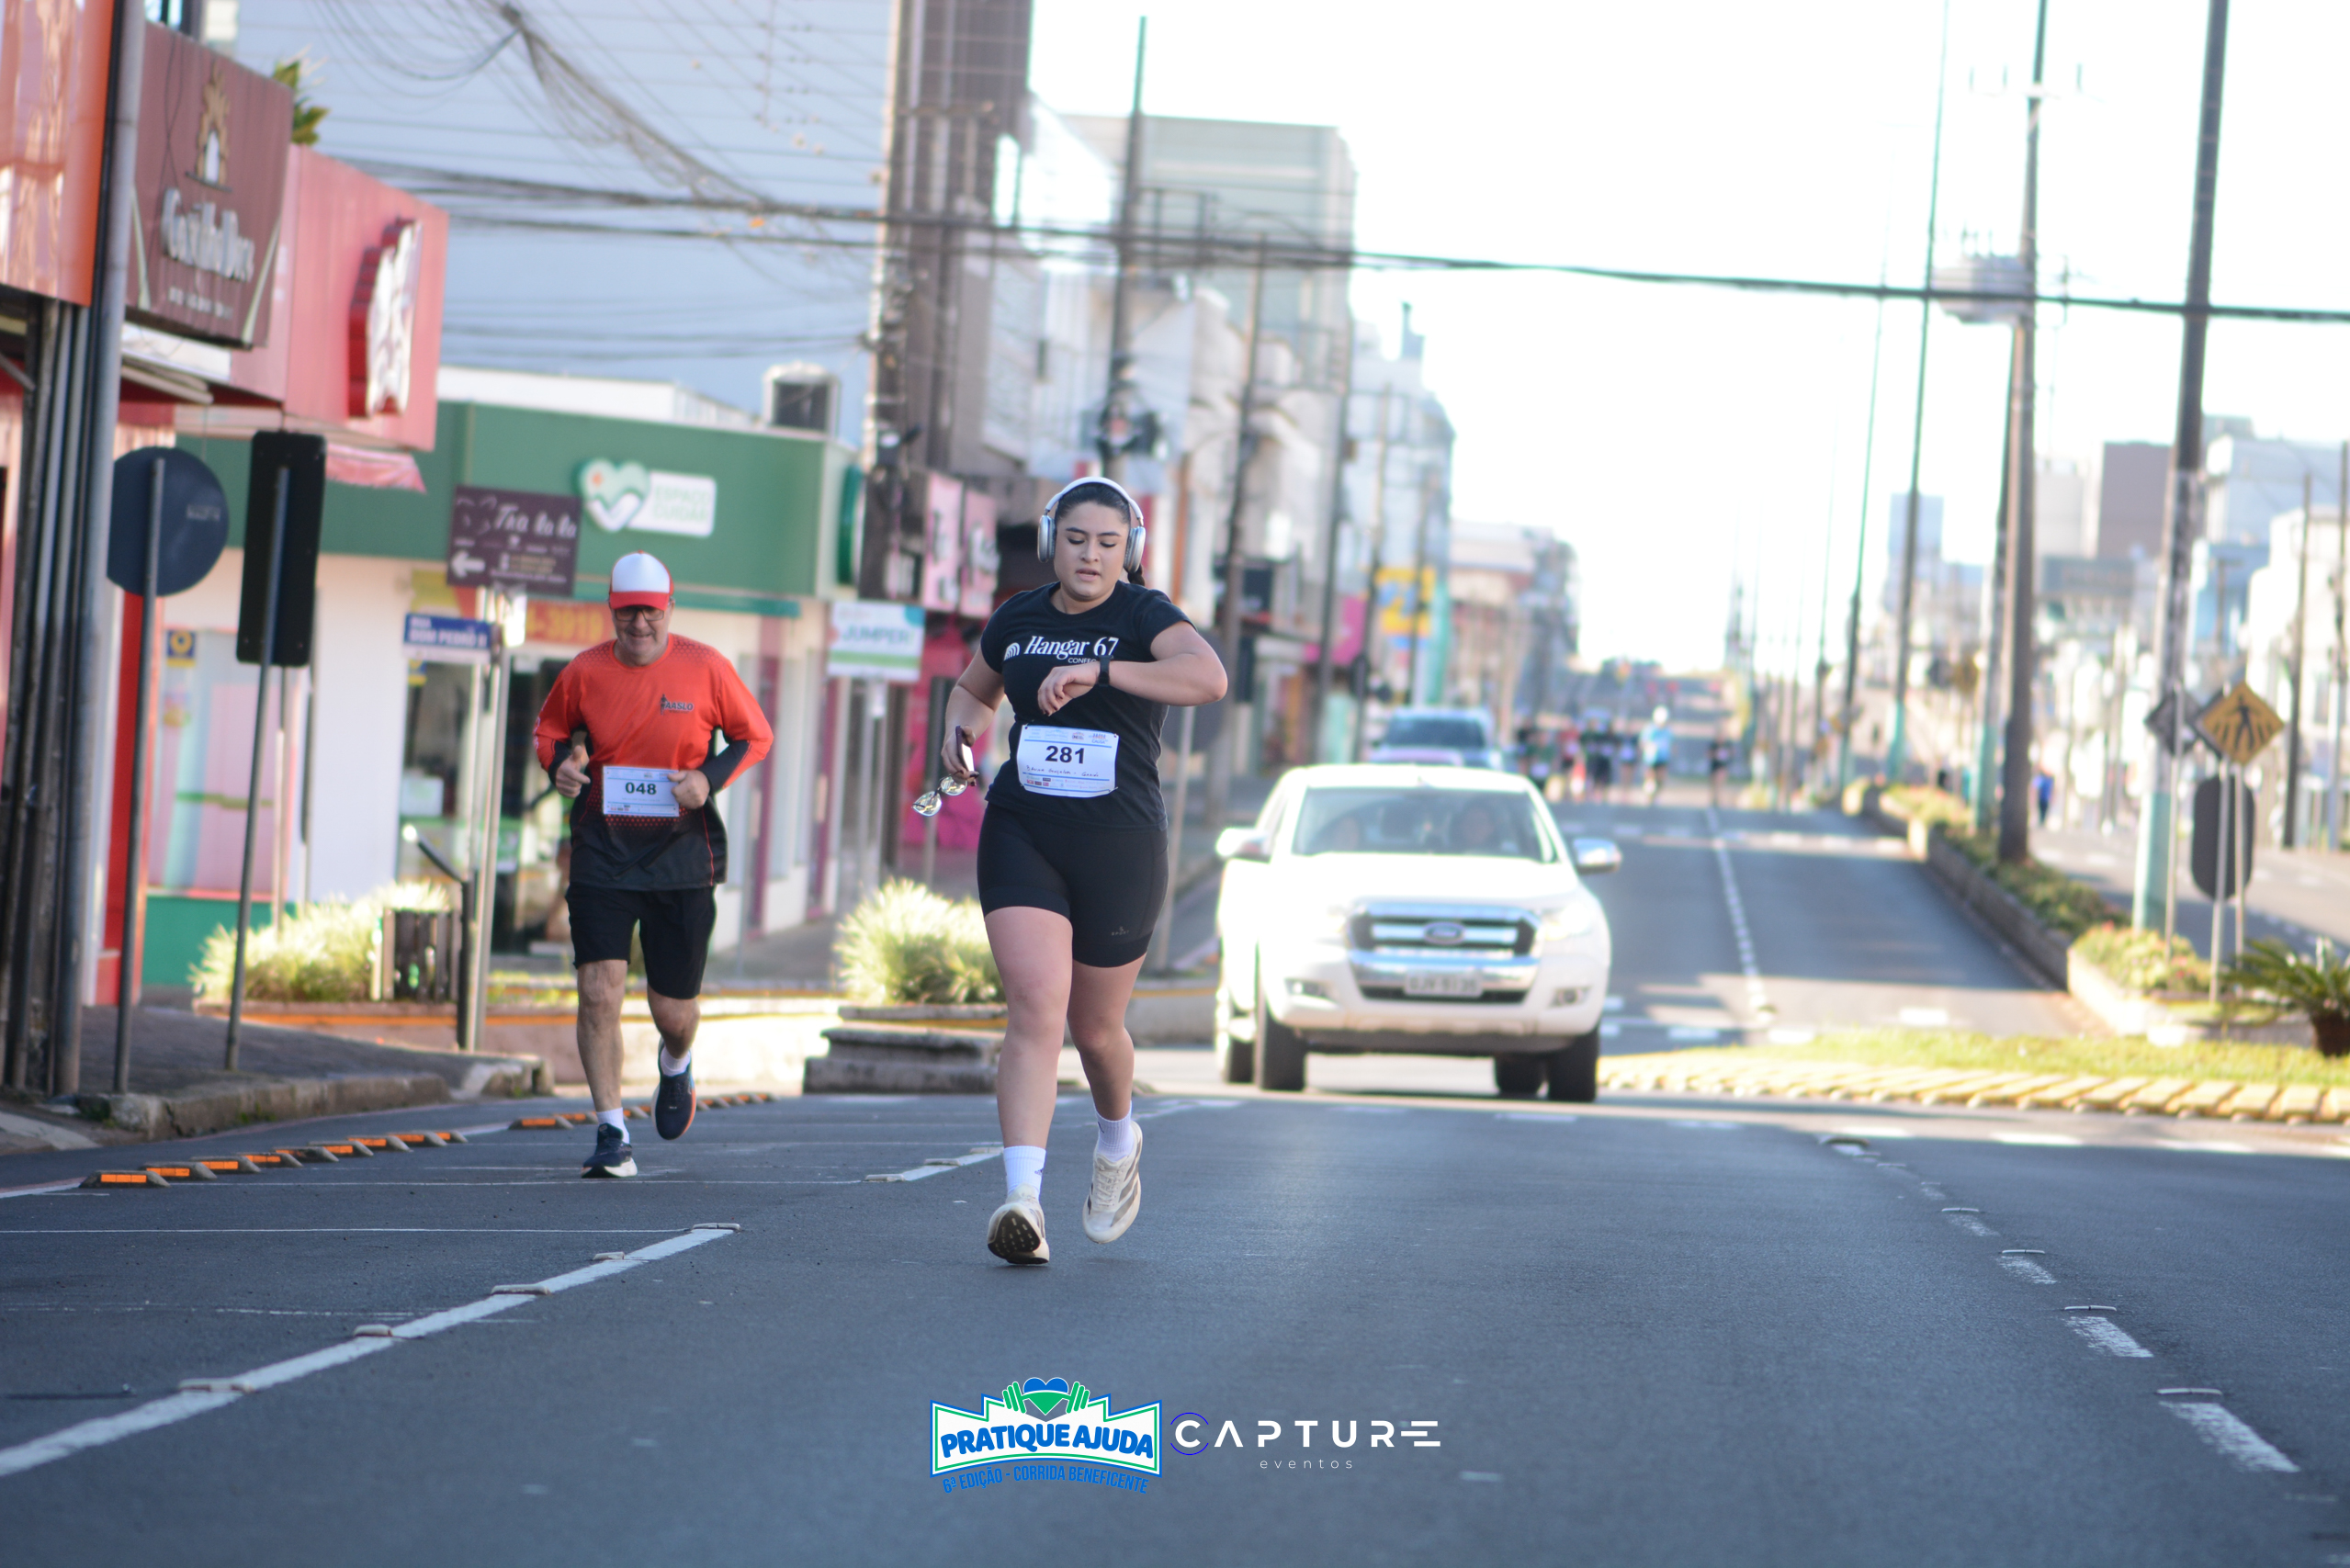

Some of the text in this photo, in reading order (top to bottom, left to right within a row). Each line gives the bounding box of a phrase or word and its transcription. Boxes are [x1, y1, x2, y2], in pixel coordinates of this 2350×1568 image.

[1023, 636, 1120, 660] Hangar 67
[664, 701, 695, 712] AASLO
[1045, 745, 1085, 764] 281
[625, 782, 657, 795] 048
